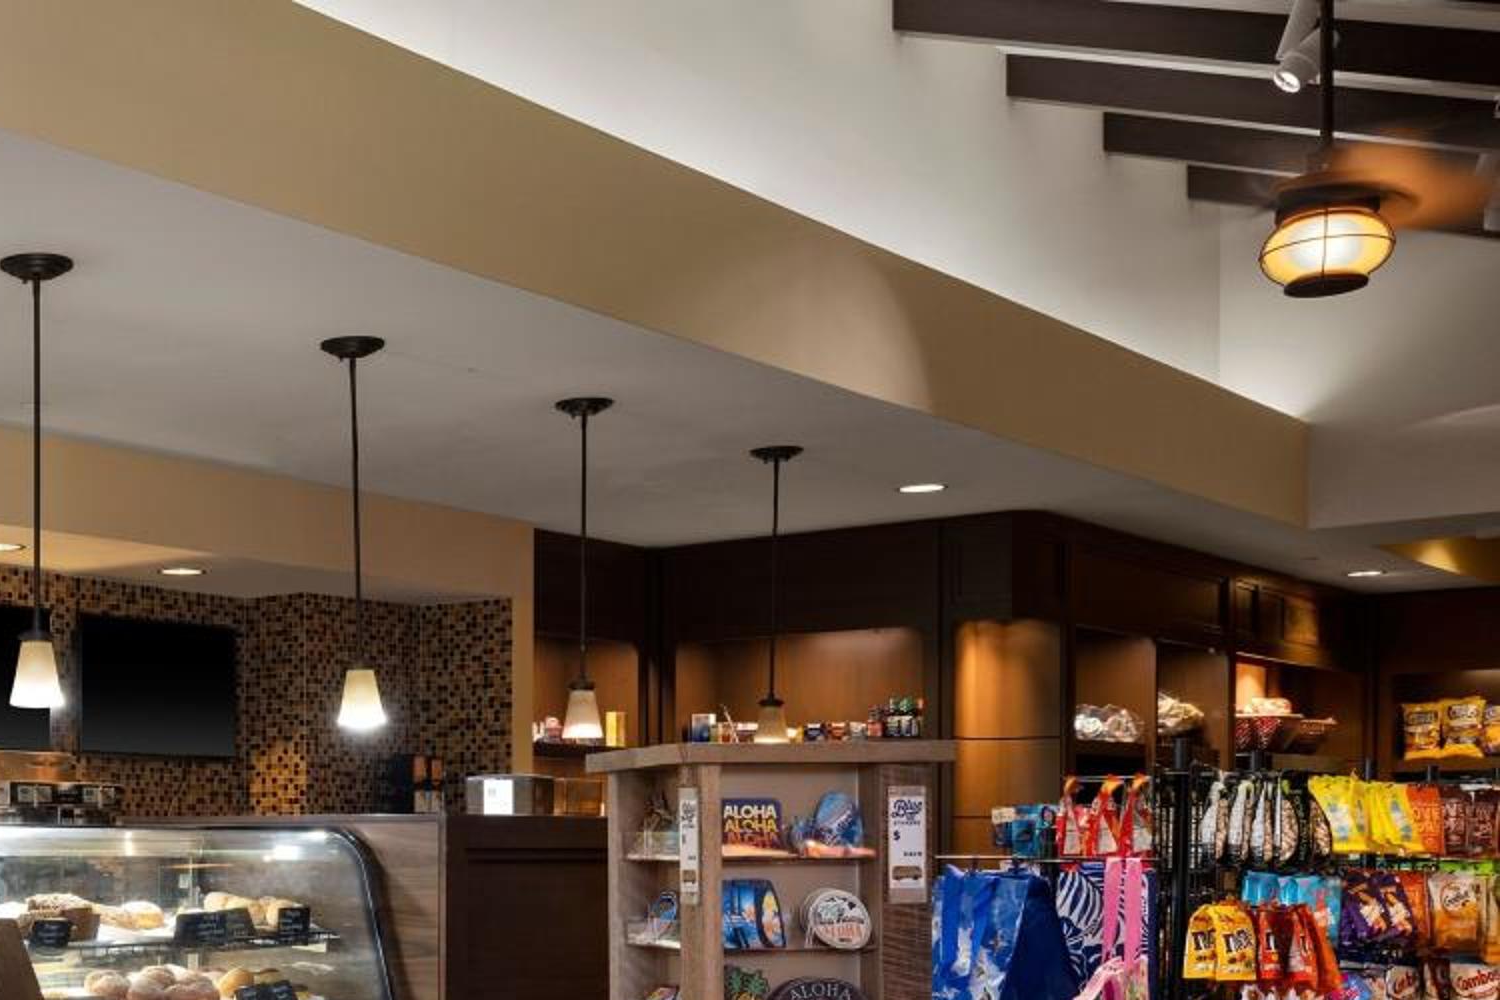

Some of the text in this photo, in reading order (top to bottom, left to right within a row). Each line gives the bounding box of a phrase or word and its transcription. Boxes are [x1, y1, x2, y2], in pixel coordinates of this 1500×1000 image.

[723, 804, 777, 819] ALOHA
[724, 818, 777, 833] ALOHA
[789, 983, 851, 1000] ALOHA
